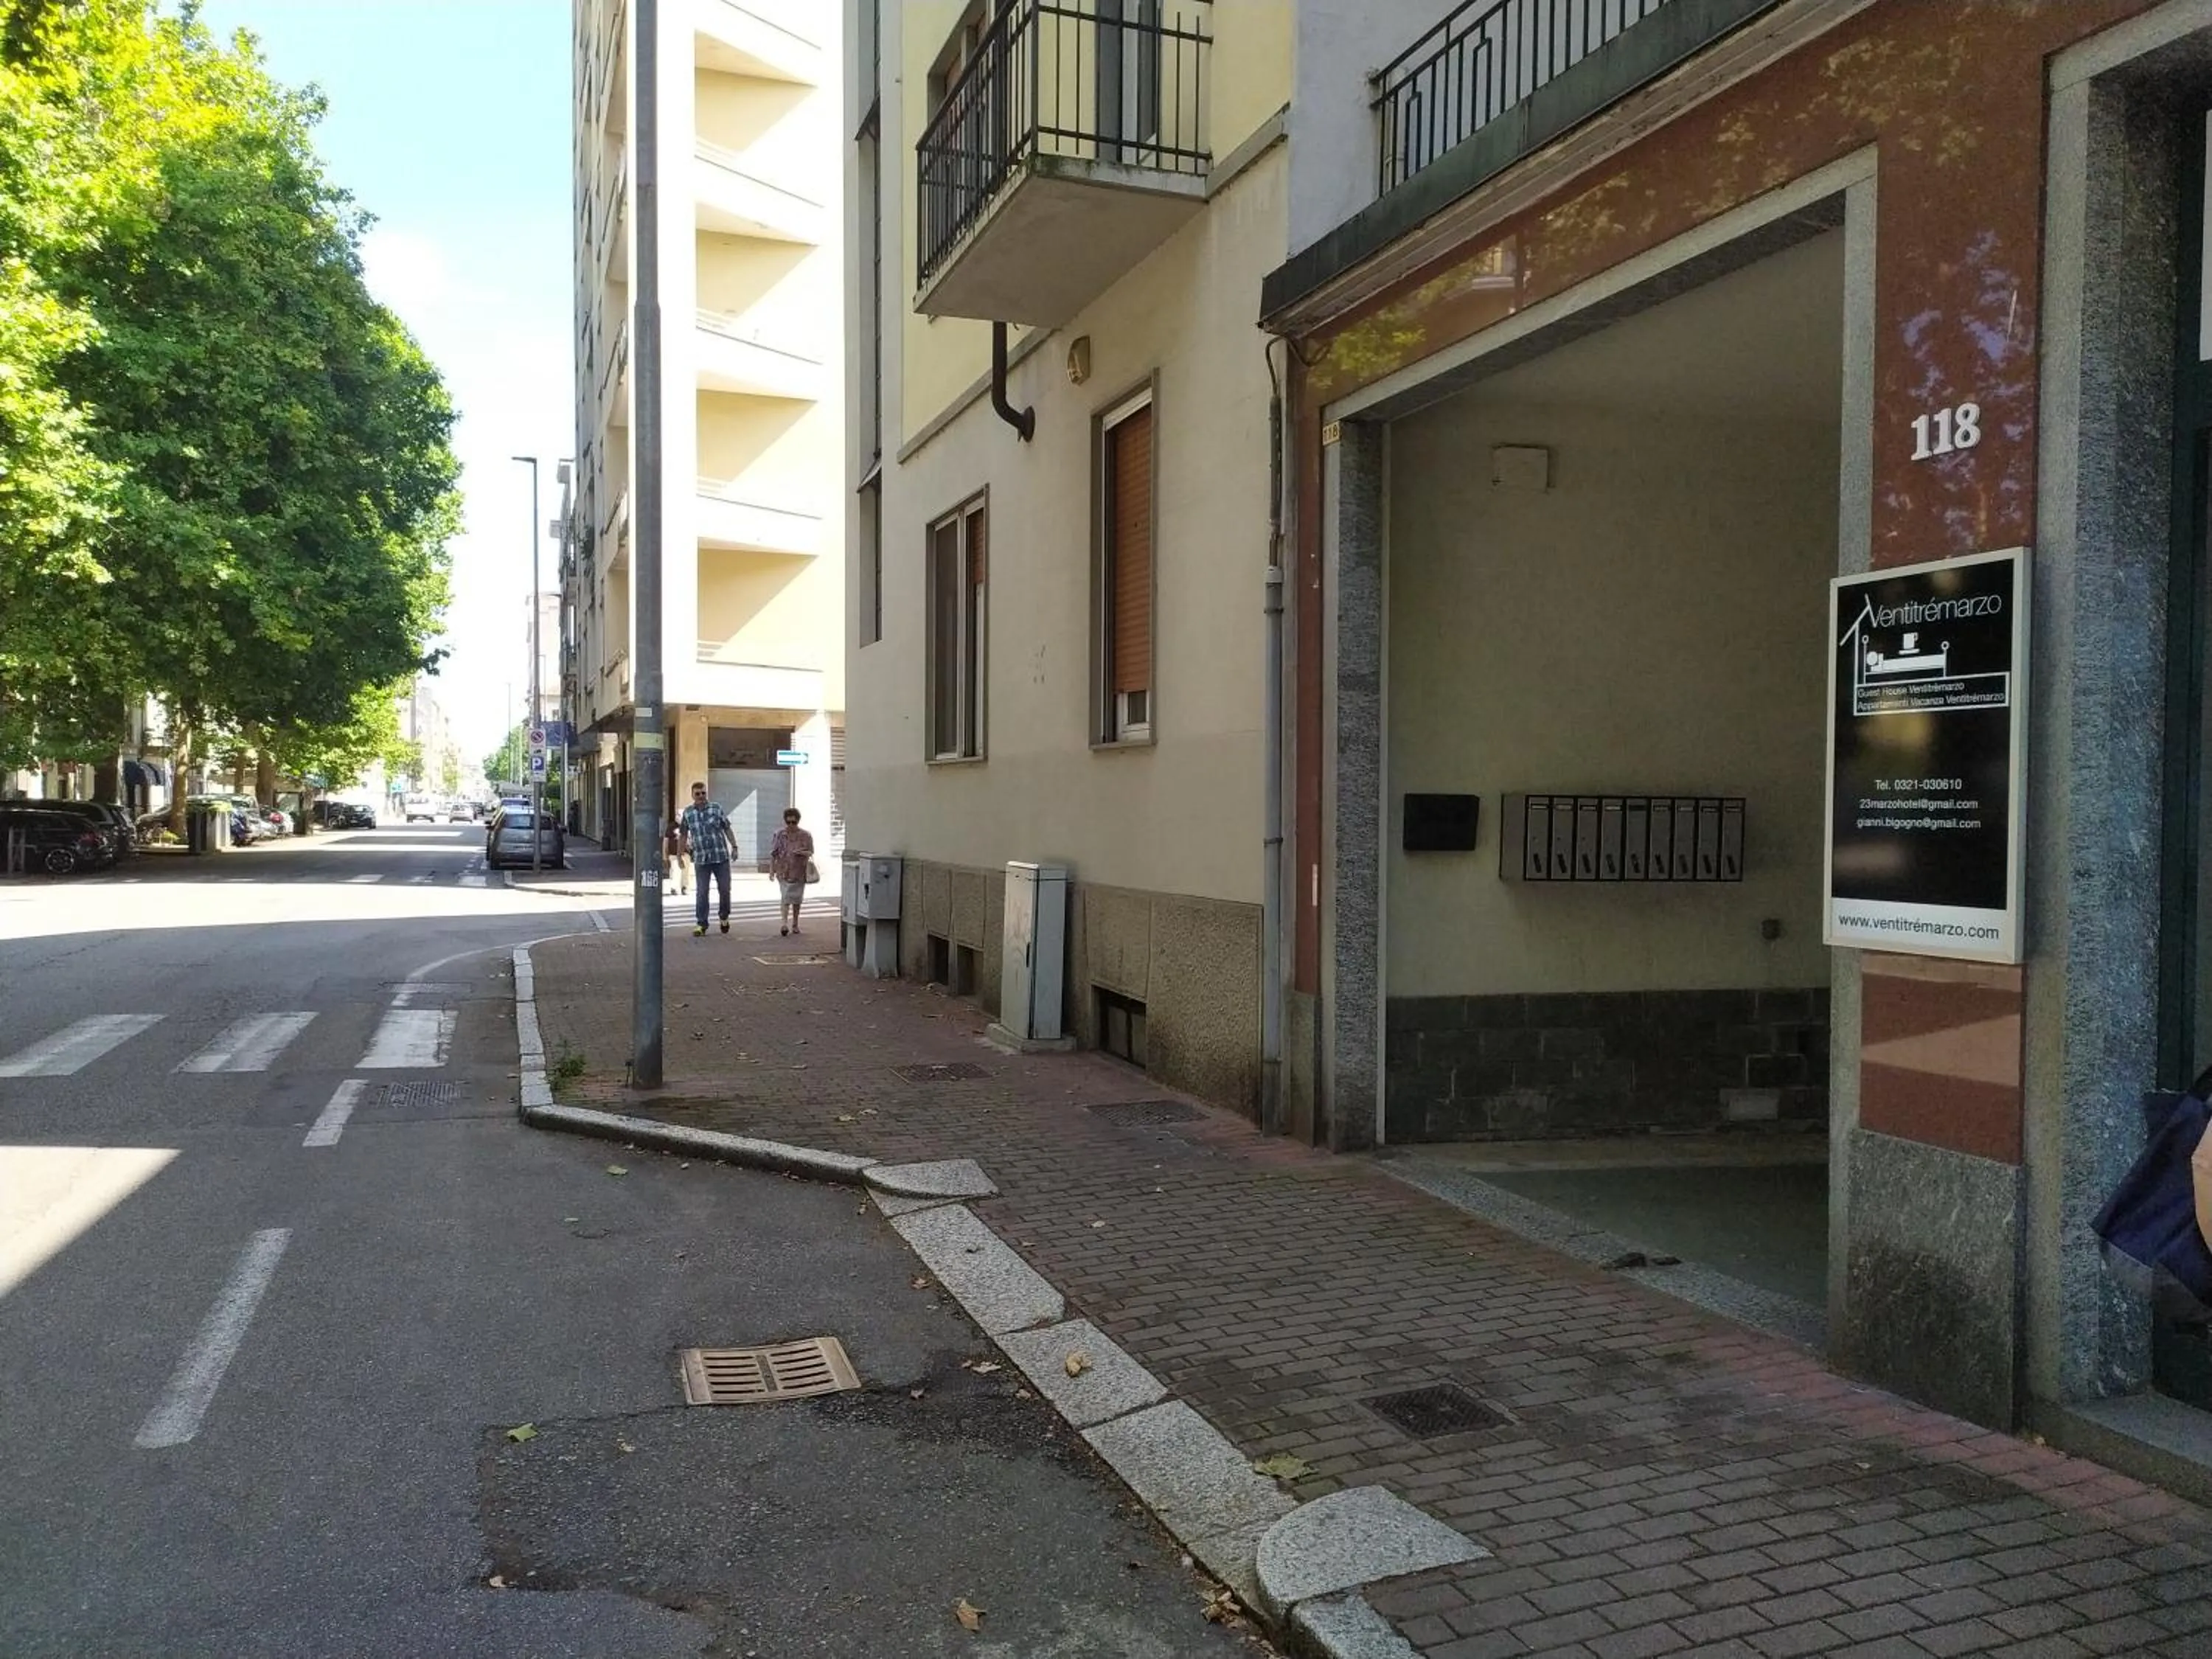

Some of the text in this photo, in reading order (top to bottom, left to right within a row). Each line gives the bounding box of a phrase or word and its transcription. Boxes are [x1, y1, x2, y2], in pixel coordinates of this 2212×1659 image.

[1910, 402, 1980, 461] 118
[1865, 593, 2002, 627] Ventitrémarzo
[1857, 682, 1964, 698] Guest House Ventitrémarzo
[1946, 692, 2005, 704] Ventitrémarzo
[1876, 779, 1963, 790] Tel. 0321-030610
[1859, 799, 1979, 812] 23marzohotel@gmail.com
[1857, 817, 1982, 830] gianni.bigogno@gmail.com
[1839, 914, 2000, 940] www.ventitrémarzo.com
